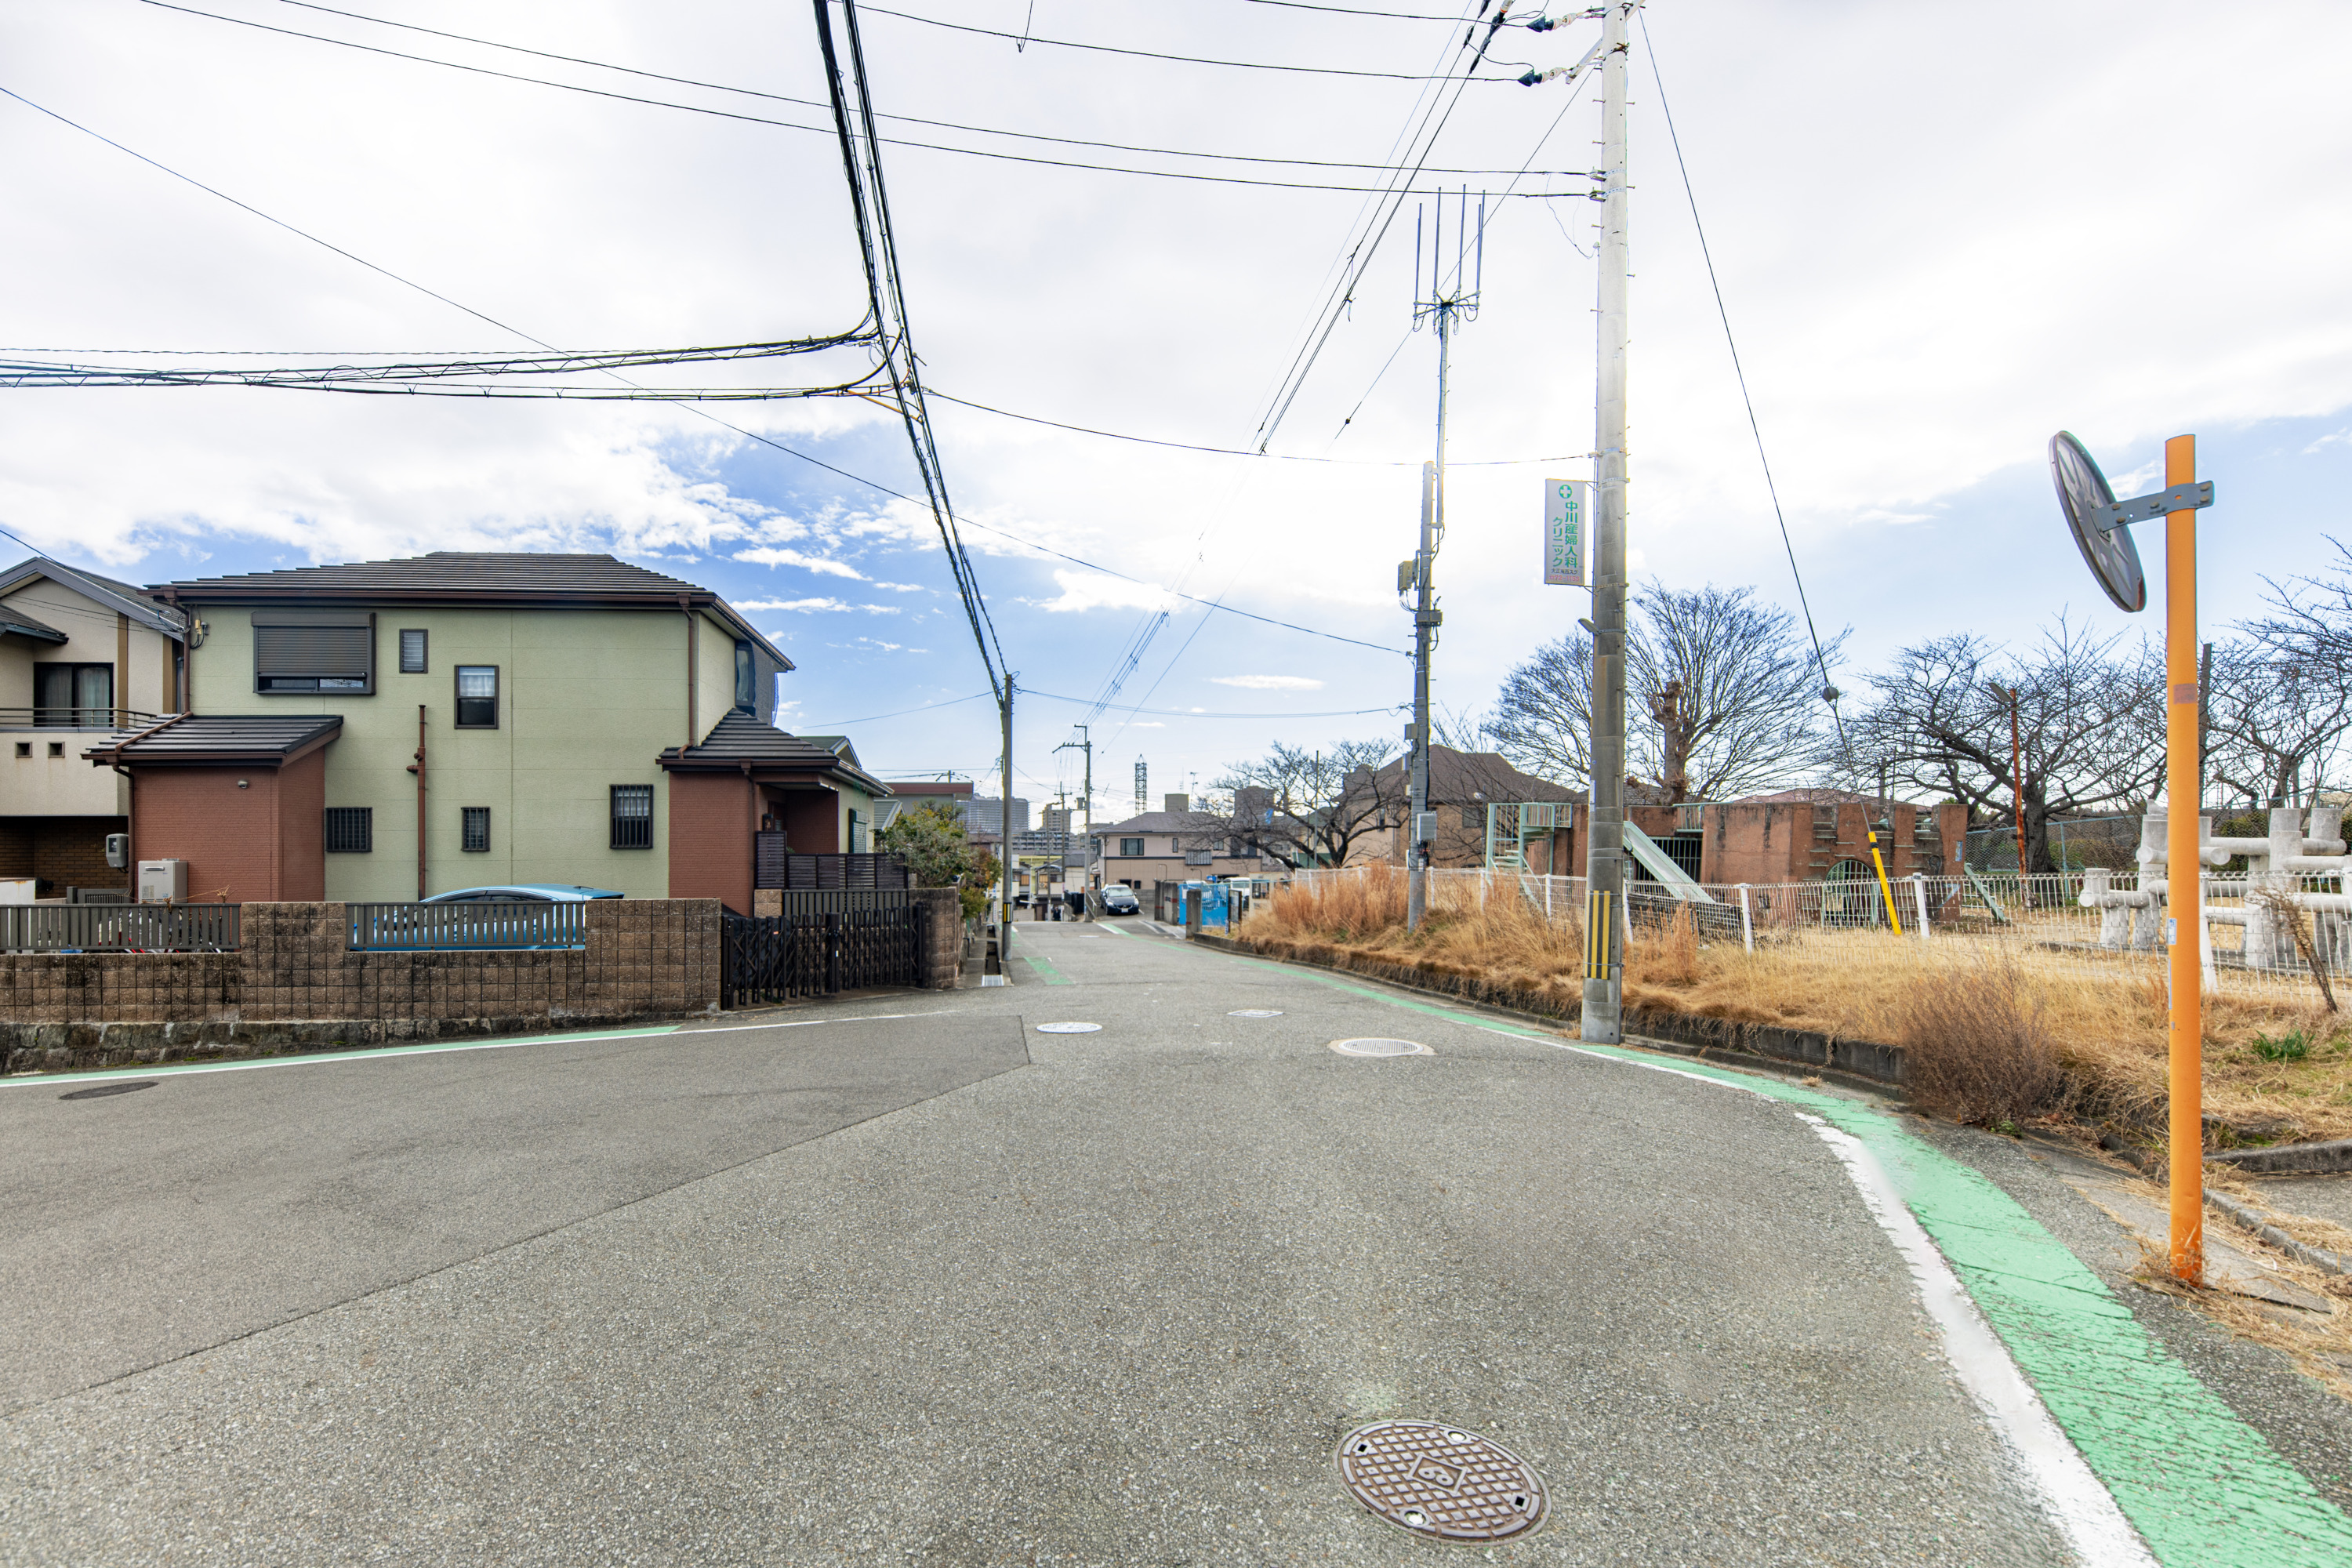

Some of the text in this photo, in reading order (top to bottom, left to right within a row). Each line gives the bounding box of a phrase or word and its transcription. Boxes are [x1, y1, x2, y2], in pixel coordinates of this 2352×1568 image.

[1552, 517, 1563, 567] クリニック
[1565, 500, 1578, 568] 中川産婦人科
